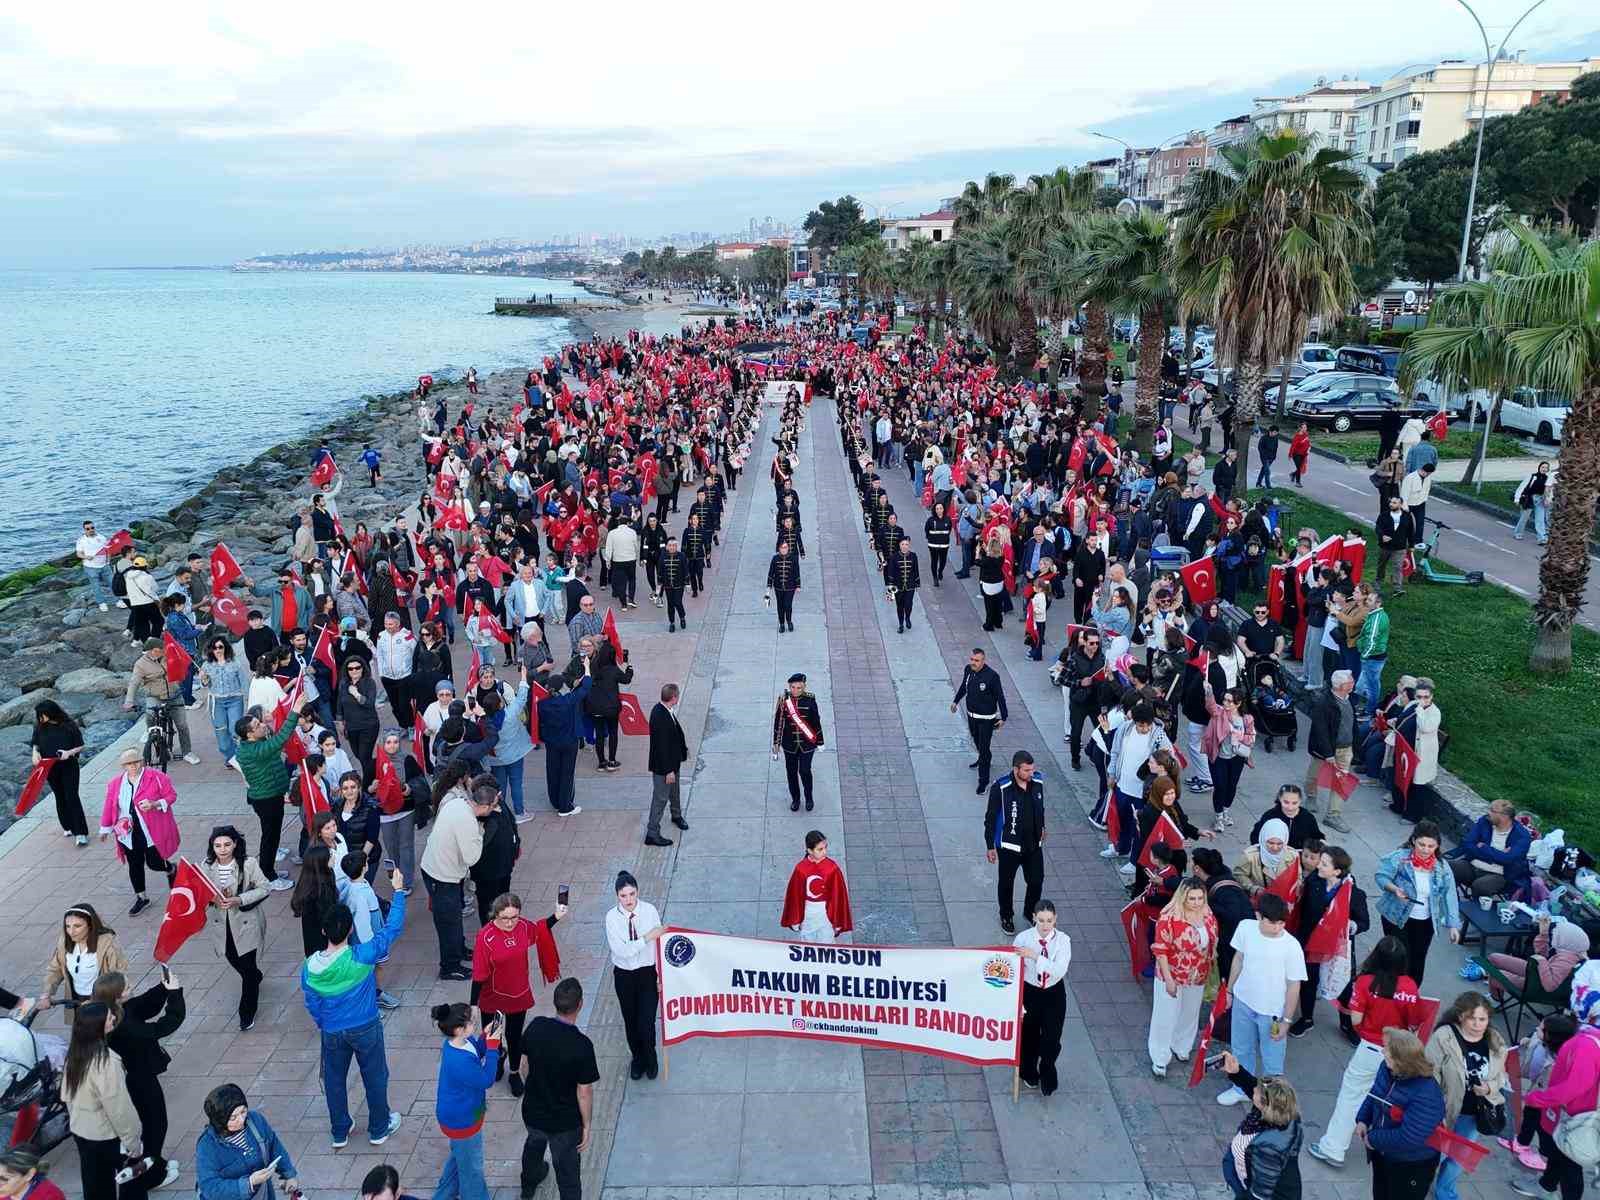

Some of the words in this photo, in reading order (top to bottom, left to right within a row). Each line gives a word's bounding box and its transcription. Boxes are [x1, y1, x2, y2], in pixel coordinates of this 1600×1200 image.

[788, 944, 882, 967] SAMSUN
[731, 968, 821, 995] ATAKUM
[827, 974, 947, 1003] BELEDİYESİ
[666, 992, 796, 1021] CUMHURİYET
[801, 999, 909, 1026] KADINLARI
[914, 1007, 1014, 1042] BANDOSU
